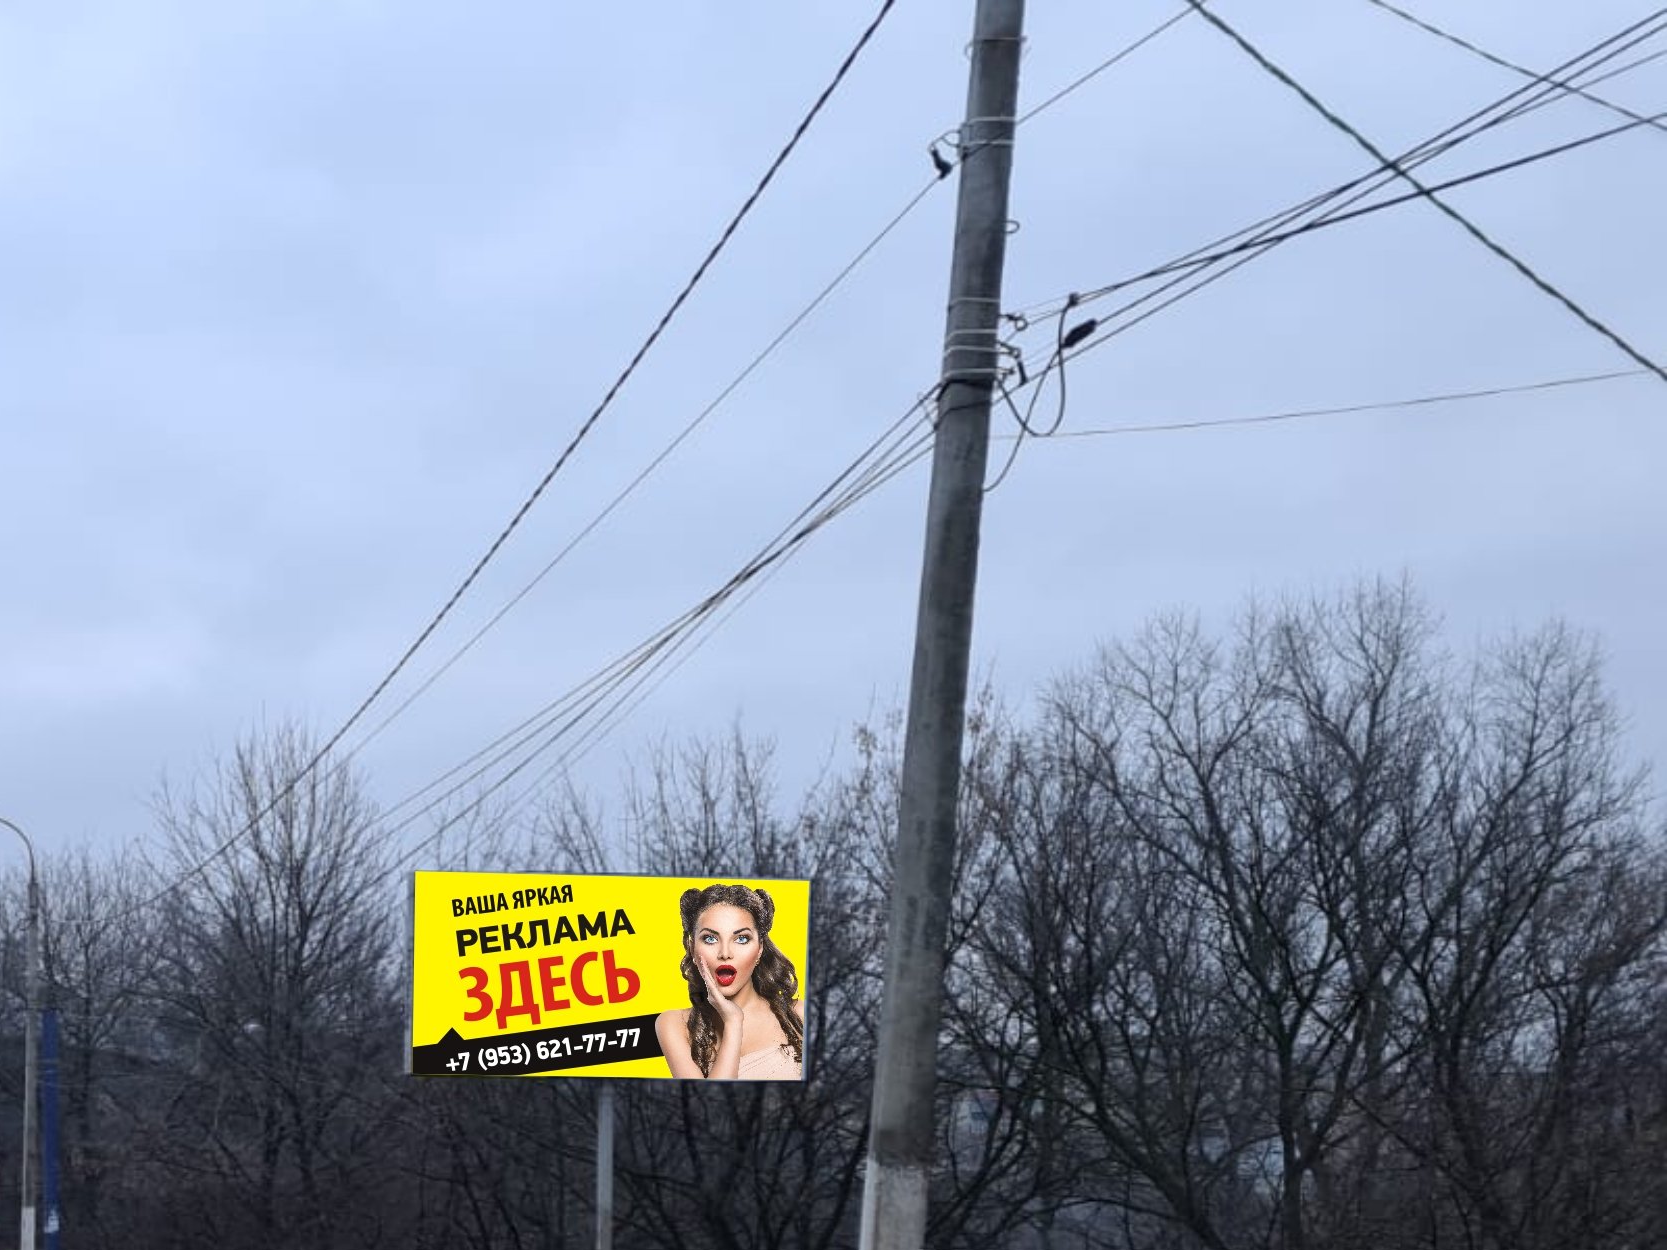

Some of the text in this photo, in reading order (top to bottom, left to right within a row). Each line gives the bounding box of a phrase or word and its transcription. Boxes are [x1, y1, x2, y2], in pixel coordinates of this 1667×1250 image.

[451, 884, 574, 917] ВАША ЯРКАЯ
[455, 908, 636, 957] РЕКЛАМА
[458, 949, 641, 1030] ЗДЕСЬ
[445, 1027, 641, 1072] +7 (953) 621-77-77
